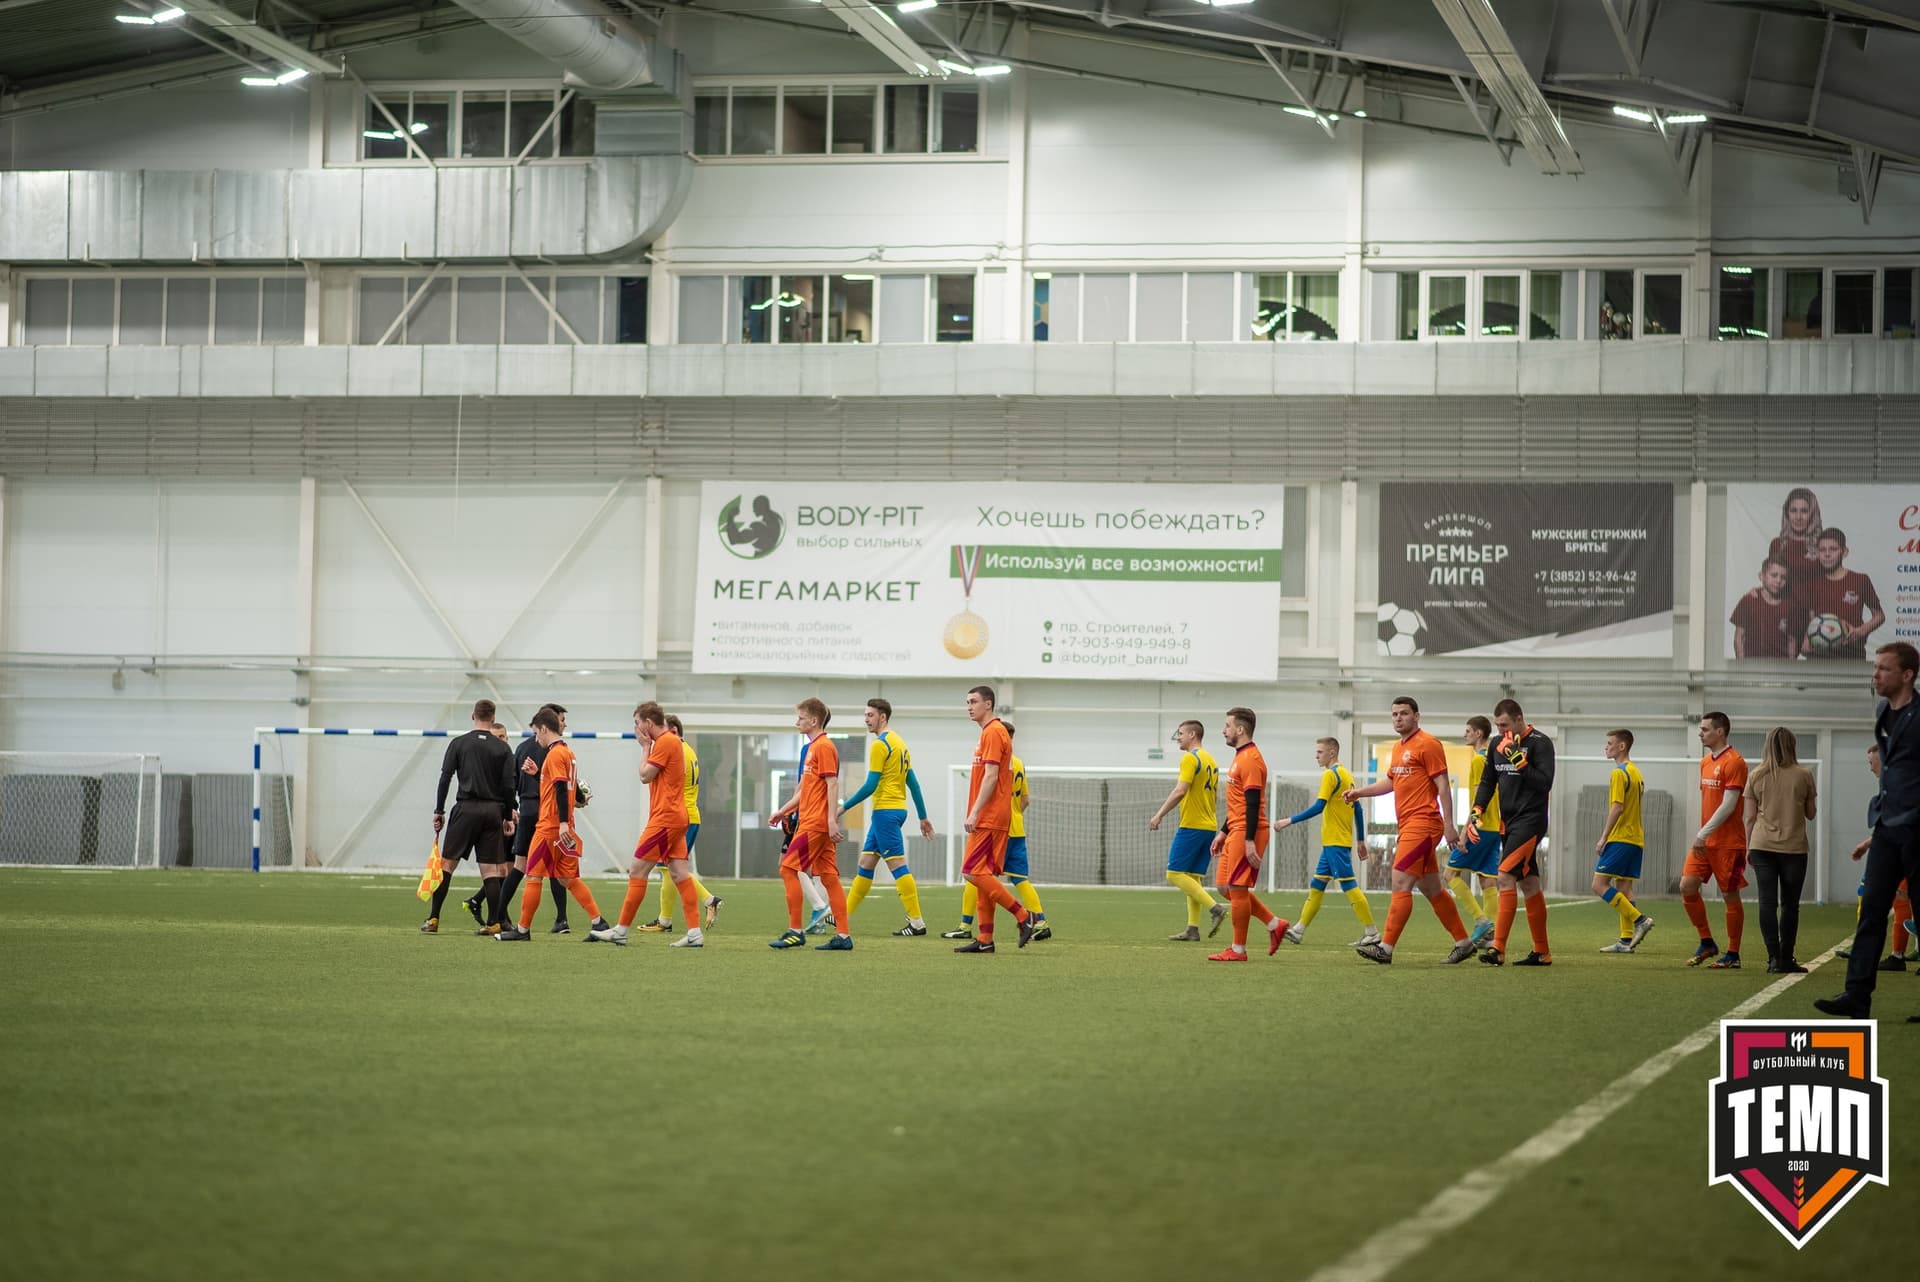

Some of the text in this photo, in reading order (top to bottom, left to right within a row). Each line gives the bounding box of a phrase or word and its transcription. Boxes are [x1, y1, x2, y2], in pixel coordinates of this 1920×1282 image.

[797, 505, 924, 527] BODY-PIT
[976, 506, 1265, 533] Хочешь побеждать?
[1424, 513, 1492, 530] БАРБЕРШОП
[1531, 529, 1647, 540] МУЖСКИЕ СТРИЖКИ
[797, 536, 923, 550] выбор сильных
[1565, 542, 1608, 553] БРИТЬЕ
[1406, 543, 1509, 562] ПРЕМЬЕР
[985, 553, 1264, 573] Используй все возможности!
[1428, 566, 1484, 585] ЛИГА
[1535, 569, 1637, 583] +7 (3852) 52-96-42
[714, 579, 921, 601] МЕГАМАРКЕТ
[796, 621, 853, 633] добавок
[1060, 623, 1081, 637] пр.
[1181, 623, 1188, 633] 7
[716, 635, 862, 648] спортивного питания
[1060, 637, 1191, 650] +7-903-949-949-8
[1060, 652, 1188, 667] @bodypit_barnaul
